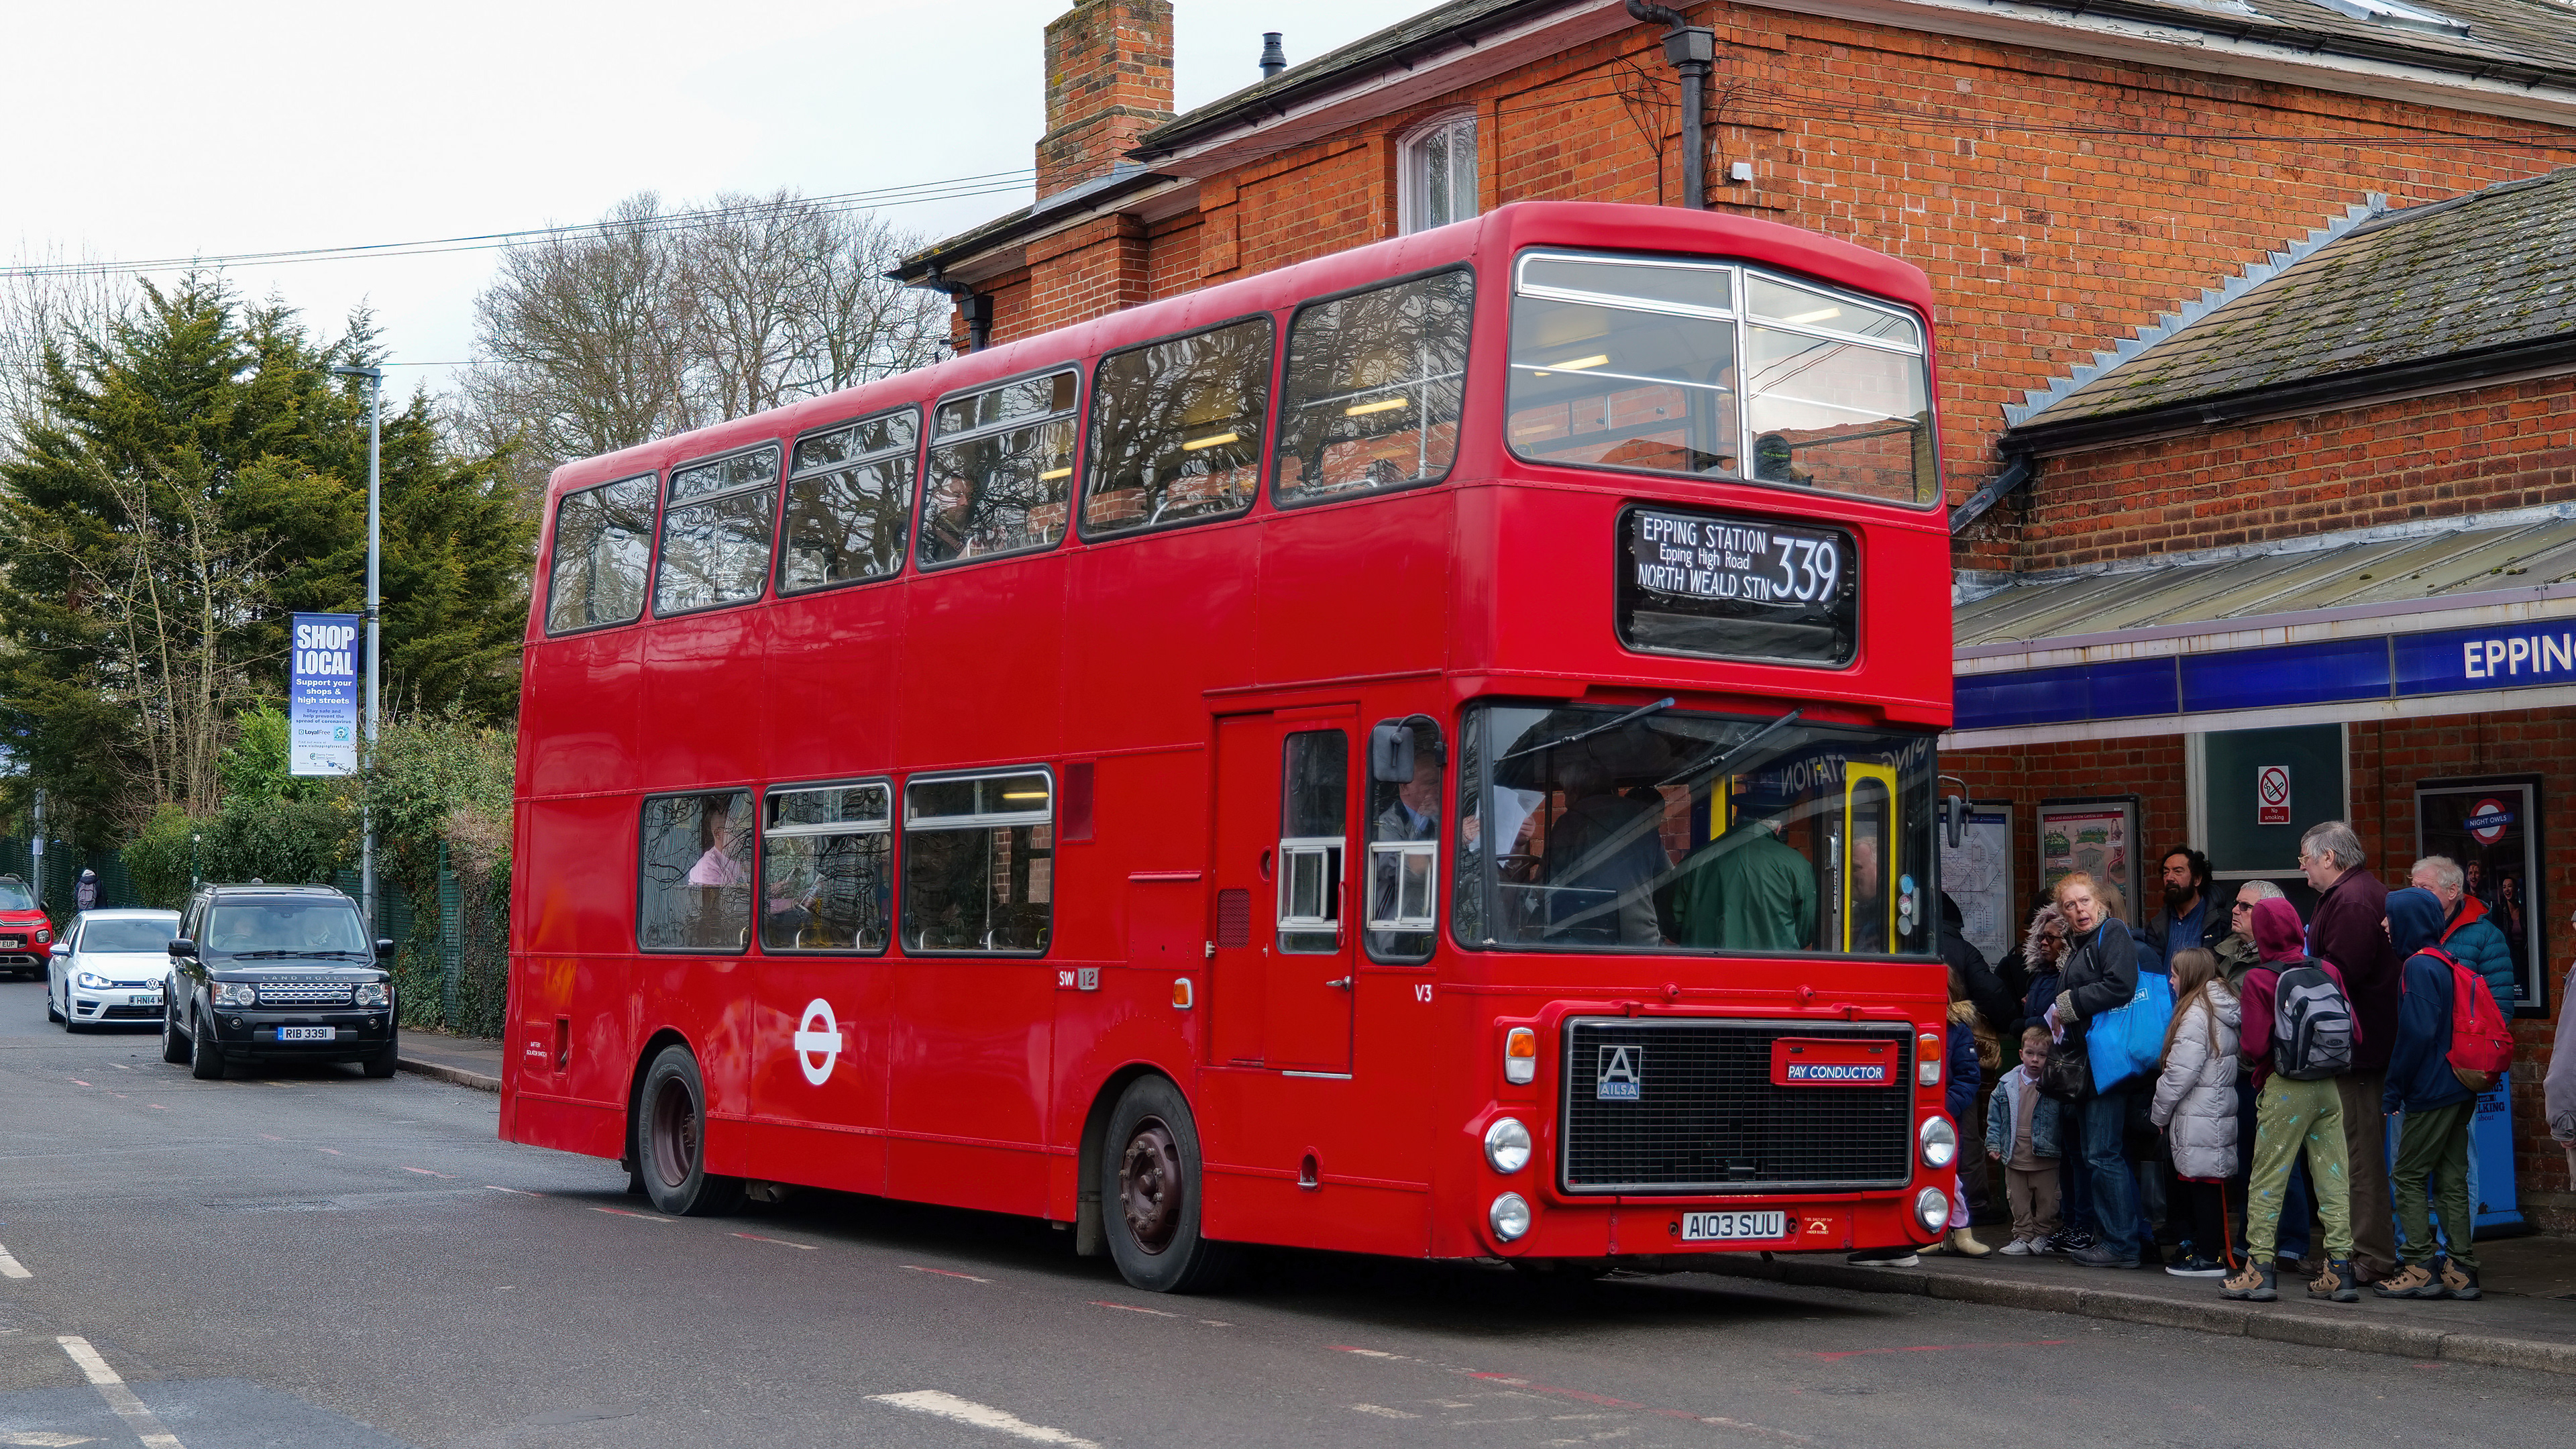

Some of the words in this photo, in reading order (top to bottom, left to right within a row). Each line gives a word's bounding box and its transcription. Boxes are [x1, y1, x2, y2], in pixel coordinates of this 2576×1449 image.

[1644, 517, 1696, 546] EPPING
[1705, 525, 1766, 554] STATION
[1660, 542, 1692, 567] Epping
[1699, 548, 1719, 570] High
[1725, 551, 1749, 570] Road
[1772, 536, 1836, 602] 339
[1638, 563, 1684, 591] NORTH
[1690, 569, 1737, 596] WEALD
[1742, 576, 1770, 600] STN
[297, 624, 355, 650] SHOP
[296, 650, 354, 676] LOCAL
[2463, 633, 2576, 678] EPPIN
[296, 678, 331, 687] Support
[306, 688, 332, 696] shops
[298, 696, 316, 705] high
[2470, 818, 2488, 827] NIGHT
[2490, 815, 2507, 823] OWLS
[1059, 971, 1074, 986] SW
[1082, 971, 1095, 986] 12
[137, 996, 155, 1004] HN14
[158, 996, 163, 1004] M
[1415, 984, 1432, 1002] V3
[286, 1029, 302, 1038] RIB
[305, 1029, 327, 1038] 3391
[1788, 1066, 1807, 1078] PAY
[1810, 1066, 1883, 1079] CONDUCTOR
[1600, 1084, 1637, 1095] AILSA
[2476, 1102, 2505, 1114] LKING
[1688, 1214, 1733, 1237] A103
[1738, 1214, 1779, 1236] SUU
